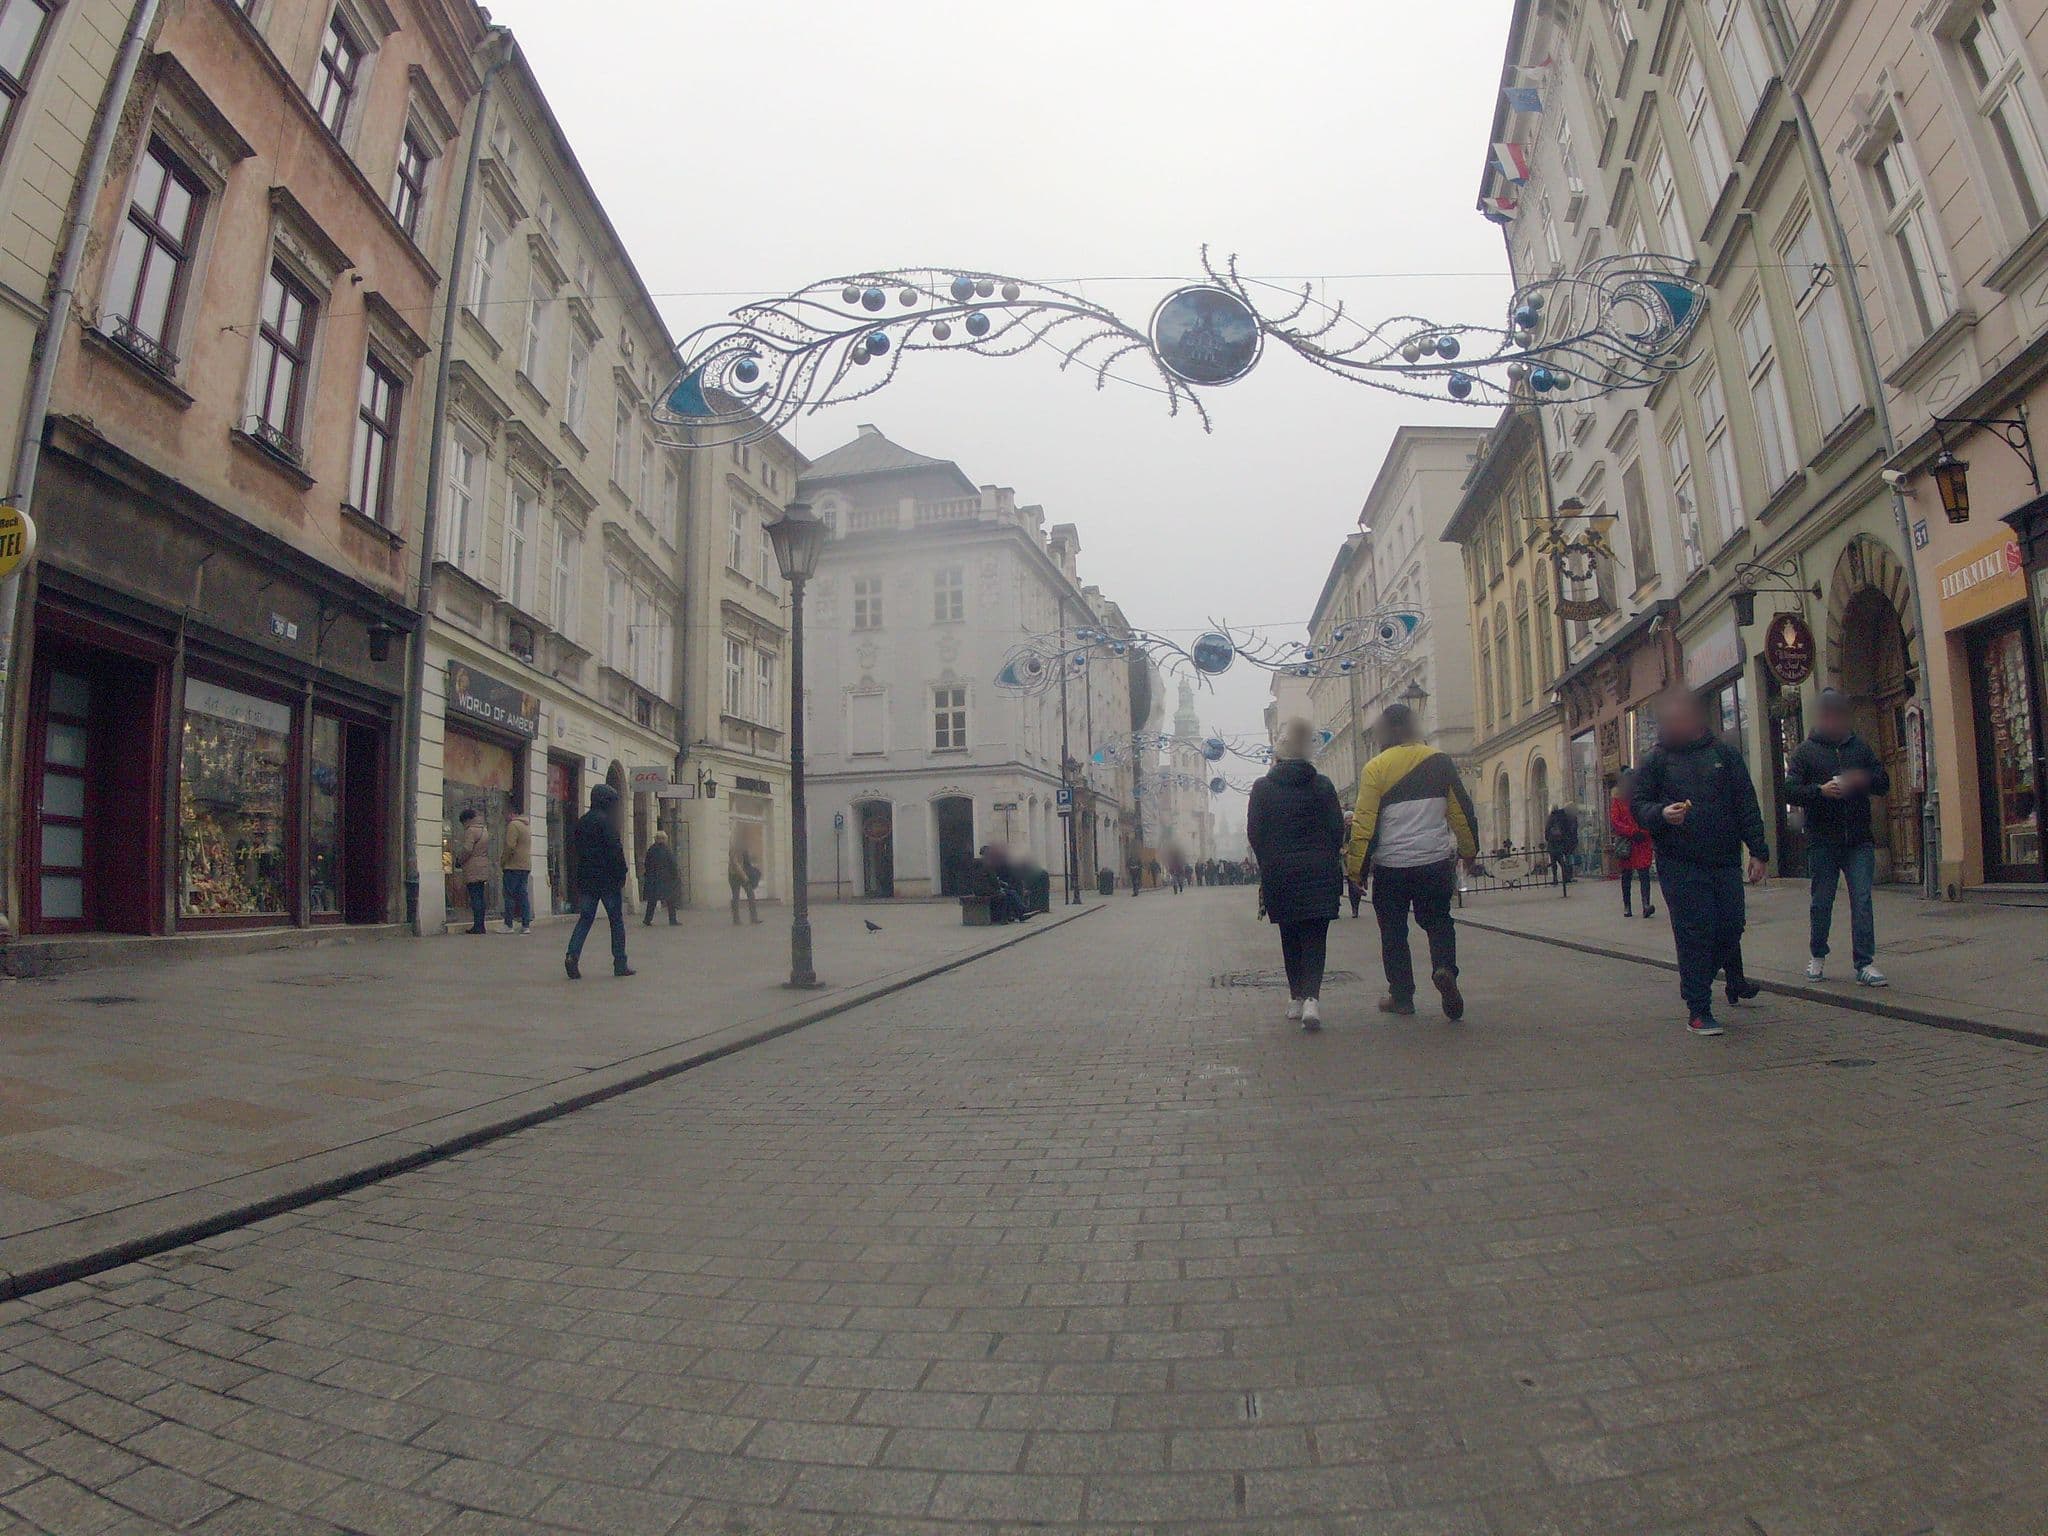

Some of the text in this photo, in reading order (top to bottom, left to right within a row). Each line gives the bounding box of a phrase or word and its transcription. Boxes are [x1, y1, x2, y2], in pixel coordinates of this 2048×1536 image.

[1915, 527, 1928, 545] 31
[1941, 549, 2004, 600] PIERNIKI
[459, 692, 534, 733] WORLD OF AMBER
